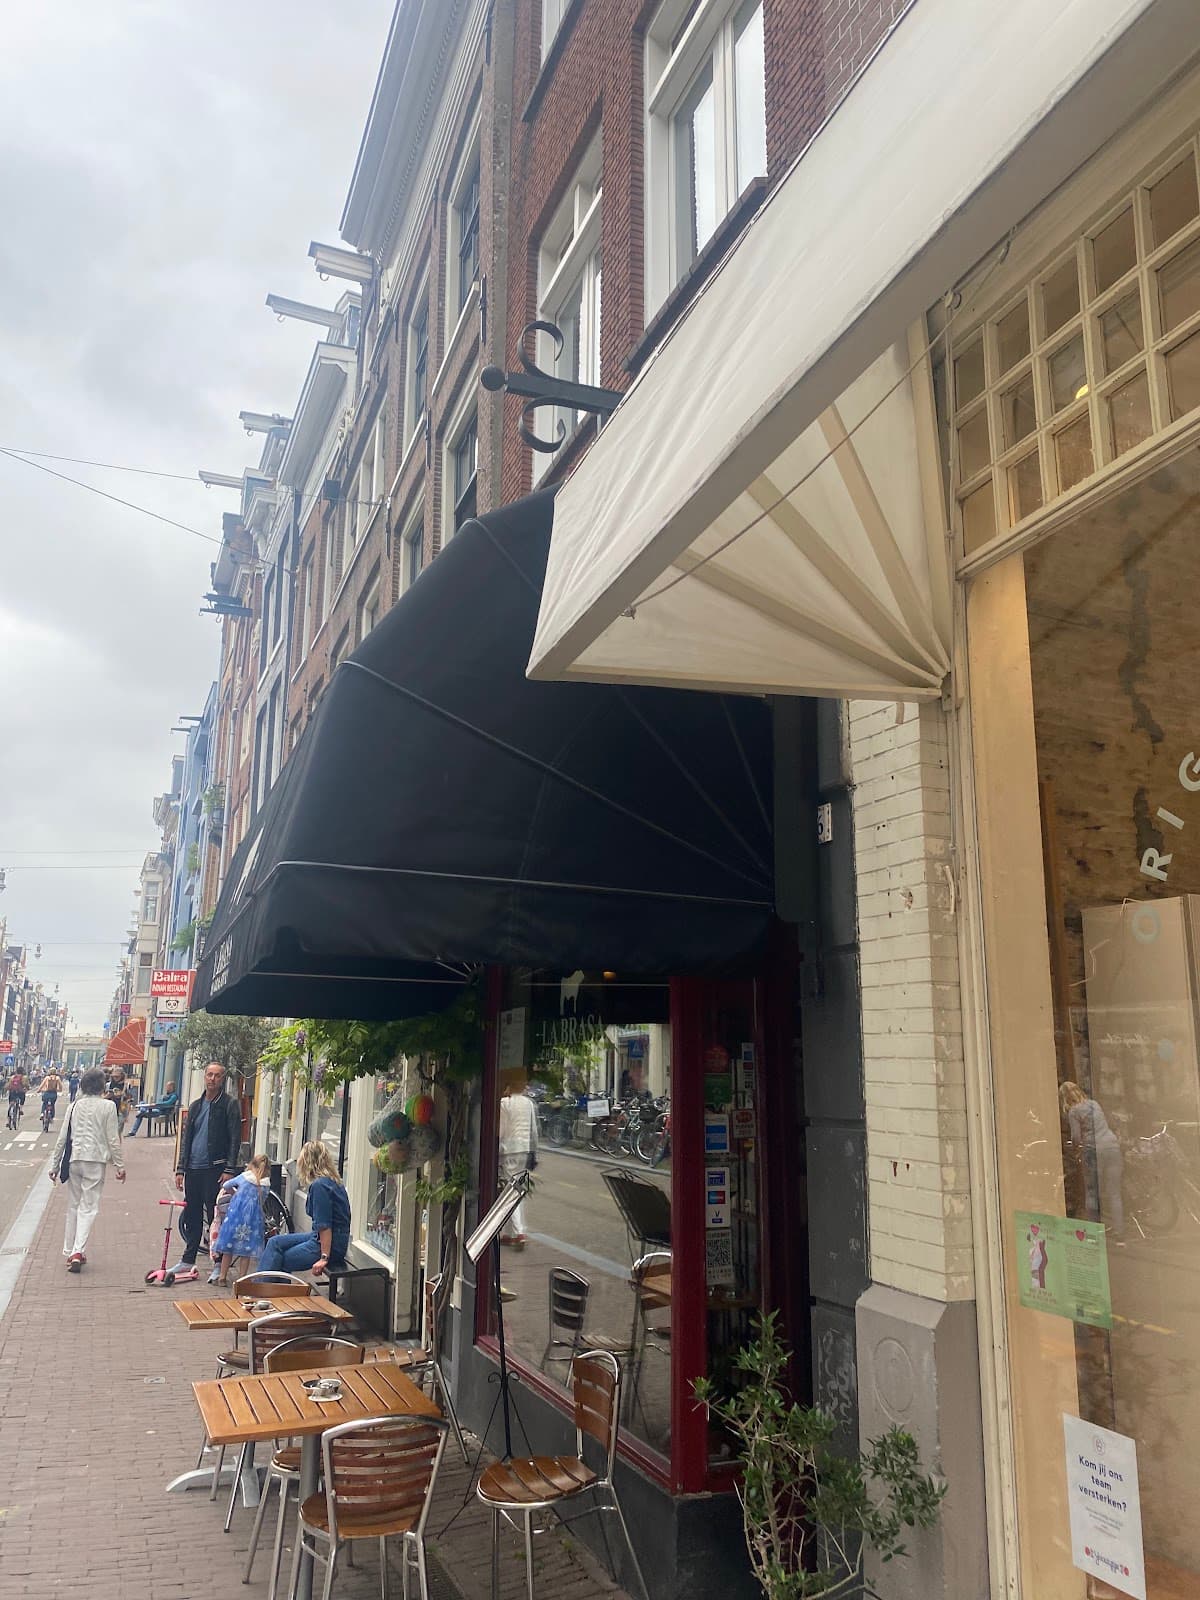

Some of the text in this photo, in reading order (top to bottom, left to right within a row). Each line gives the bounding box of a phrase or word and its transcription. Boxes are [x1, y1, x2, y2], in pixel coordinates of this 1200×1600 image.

[542, 1020, 558, 1047] LA
[560, 1014, 606, 1046] BRASA
[1078, 1455, 1124, 1482] Kom jij ons
[1091, 1476, 1112, 1491] team
[1078, 1485, 1127, 1513] versterken?
